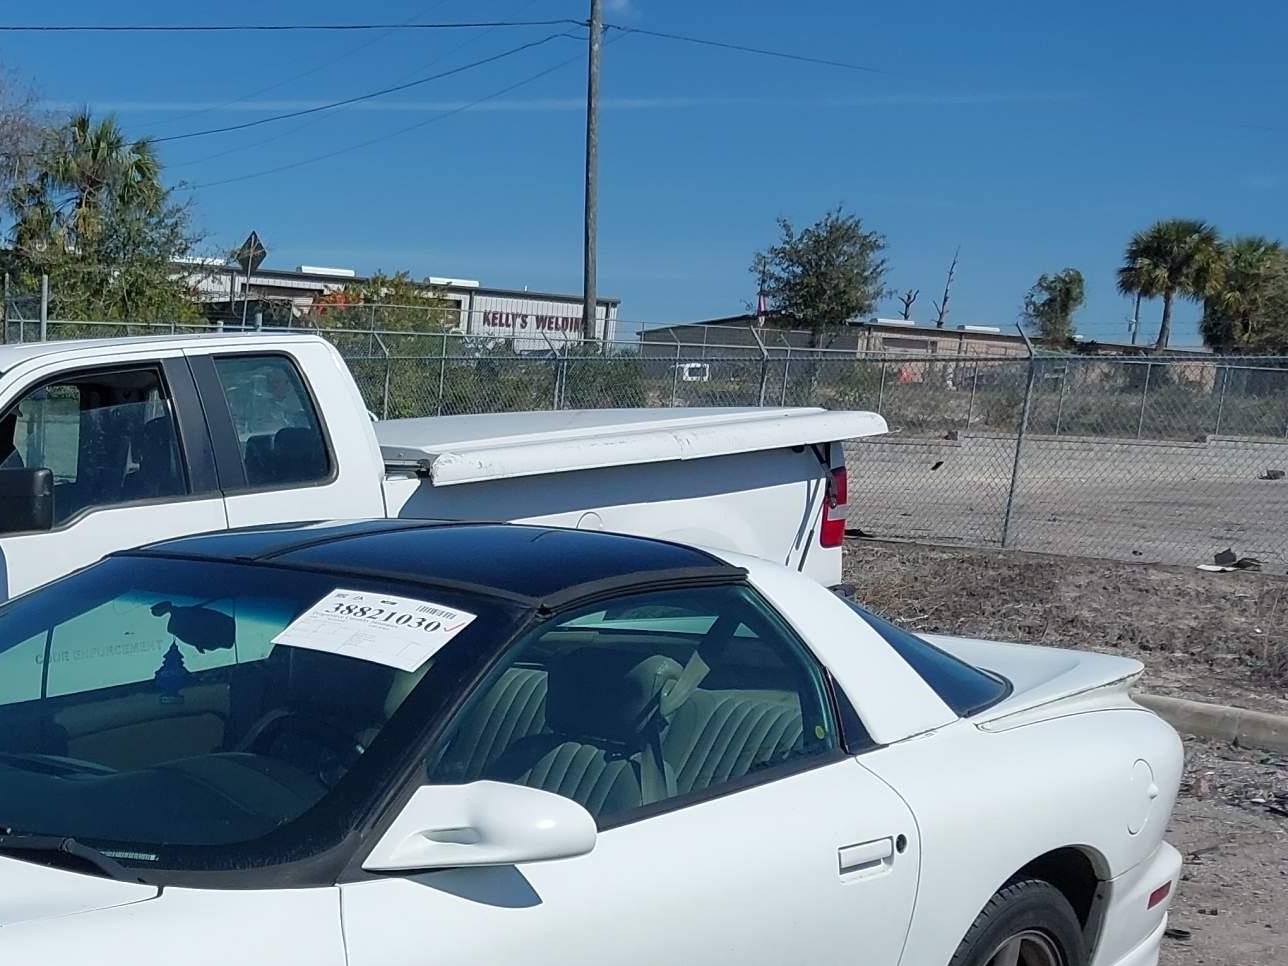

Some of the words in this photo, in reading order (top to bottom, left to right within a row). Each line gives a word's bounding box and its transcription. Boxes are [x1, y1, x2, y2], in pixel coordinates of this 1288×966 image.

[483, 309, 528, 329] KELLY'S
[535, 315, 585, 333] WELDIN
[324, 602, 442, 632] 38821030
